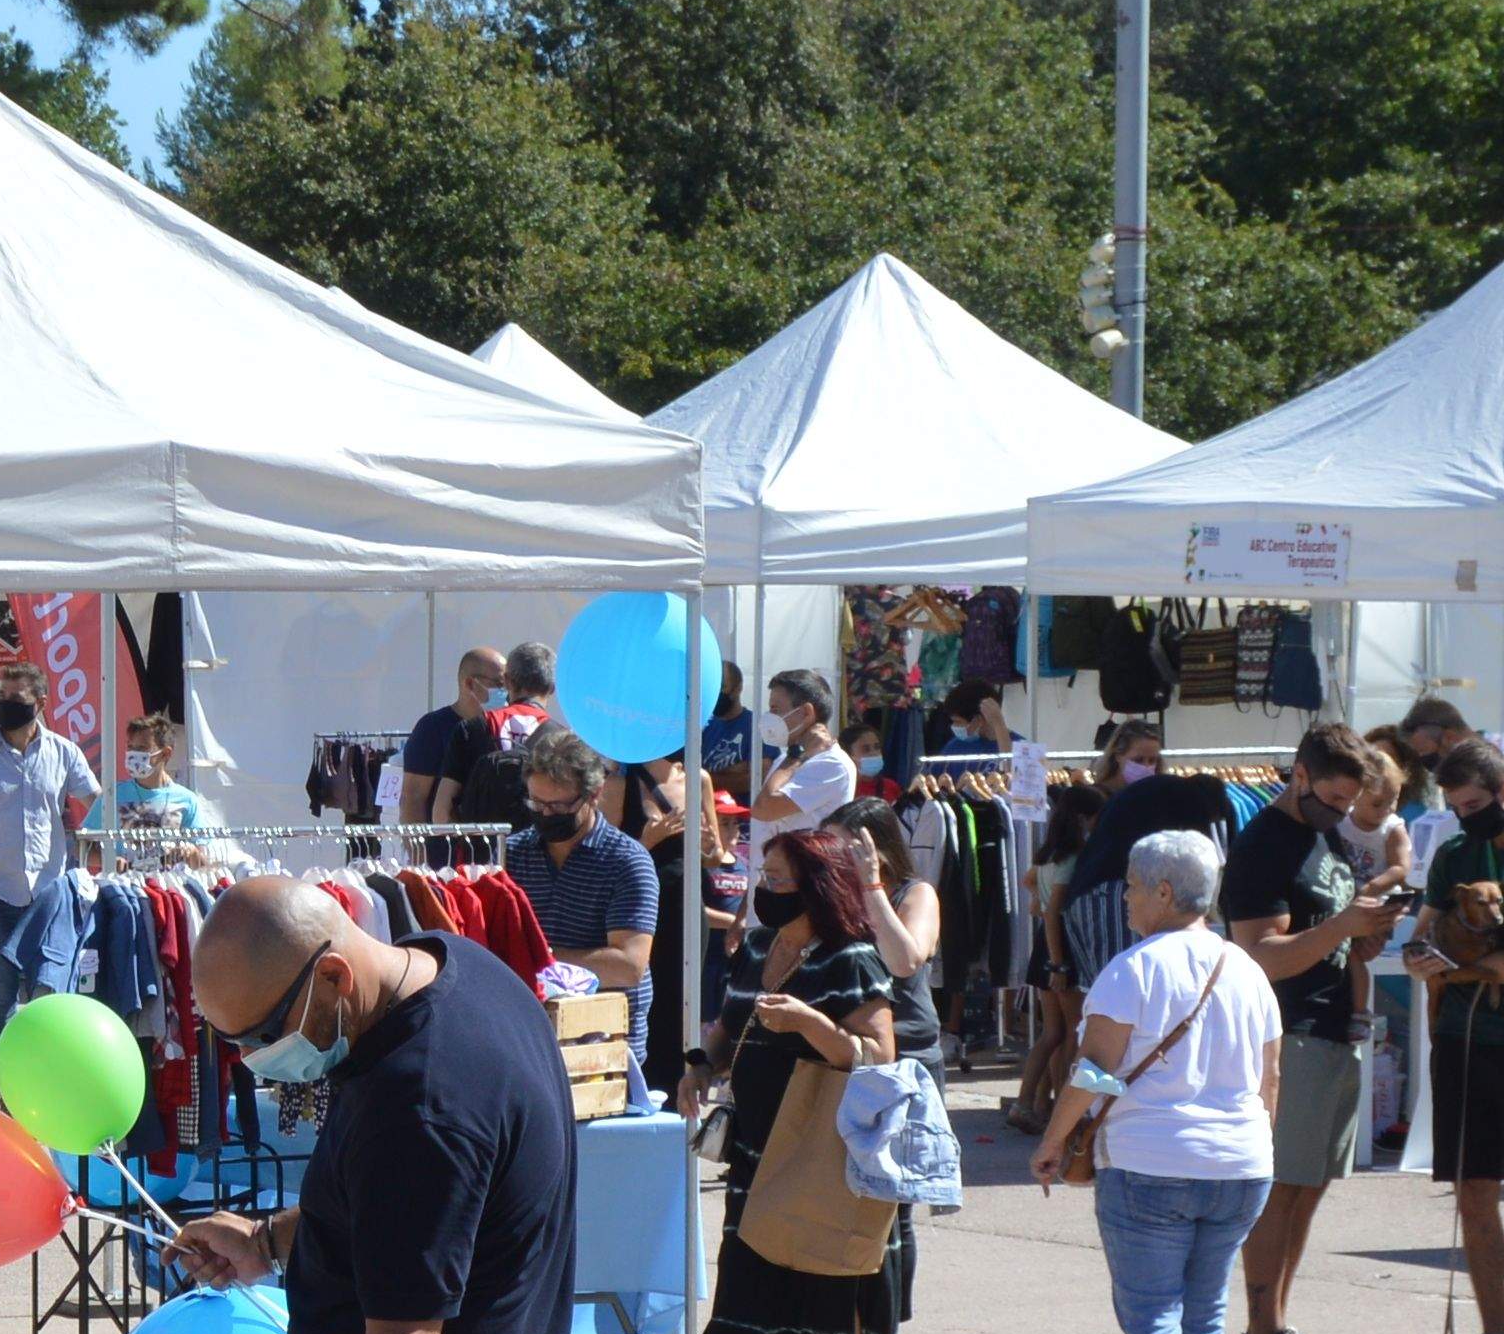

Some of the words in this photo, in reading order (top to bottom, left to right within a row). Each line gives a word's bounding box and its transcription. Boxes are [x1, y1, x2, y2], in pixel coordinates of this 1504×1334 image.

[1249, 539, 1267, 553] ABC
[1268, 539, 1296, 553] Centro
[1297, 539, 1338, 554] Educativo
